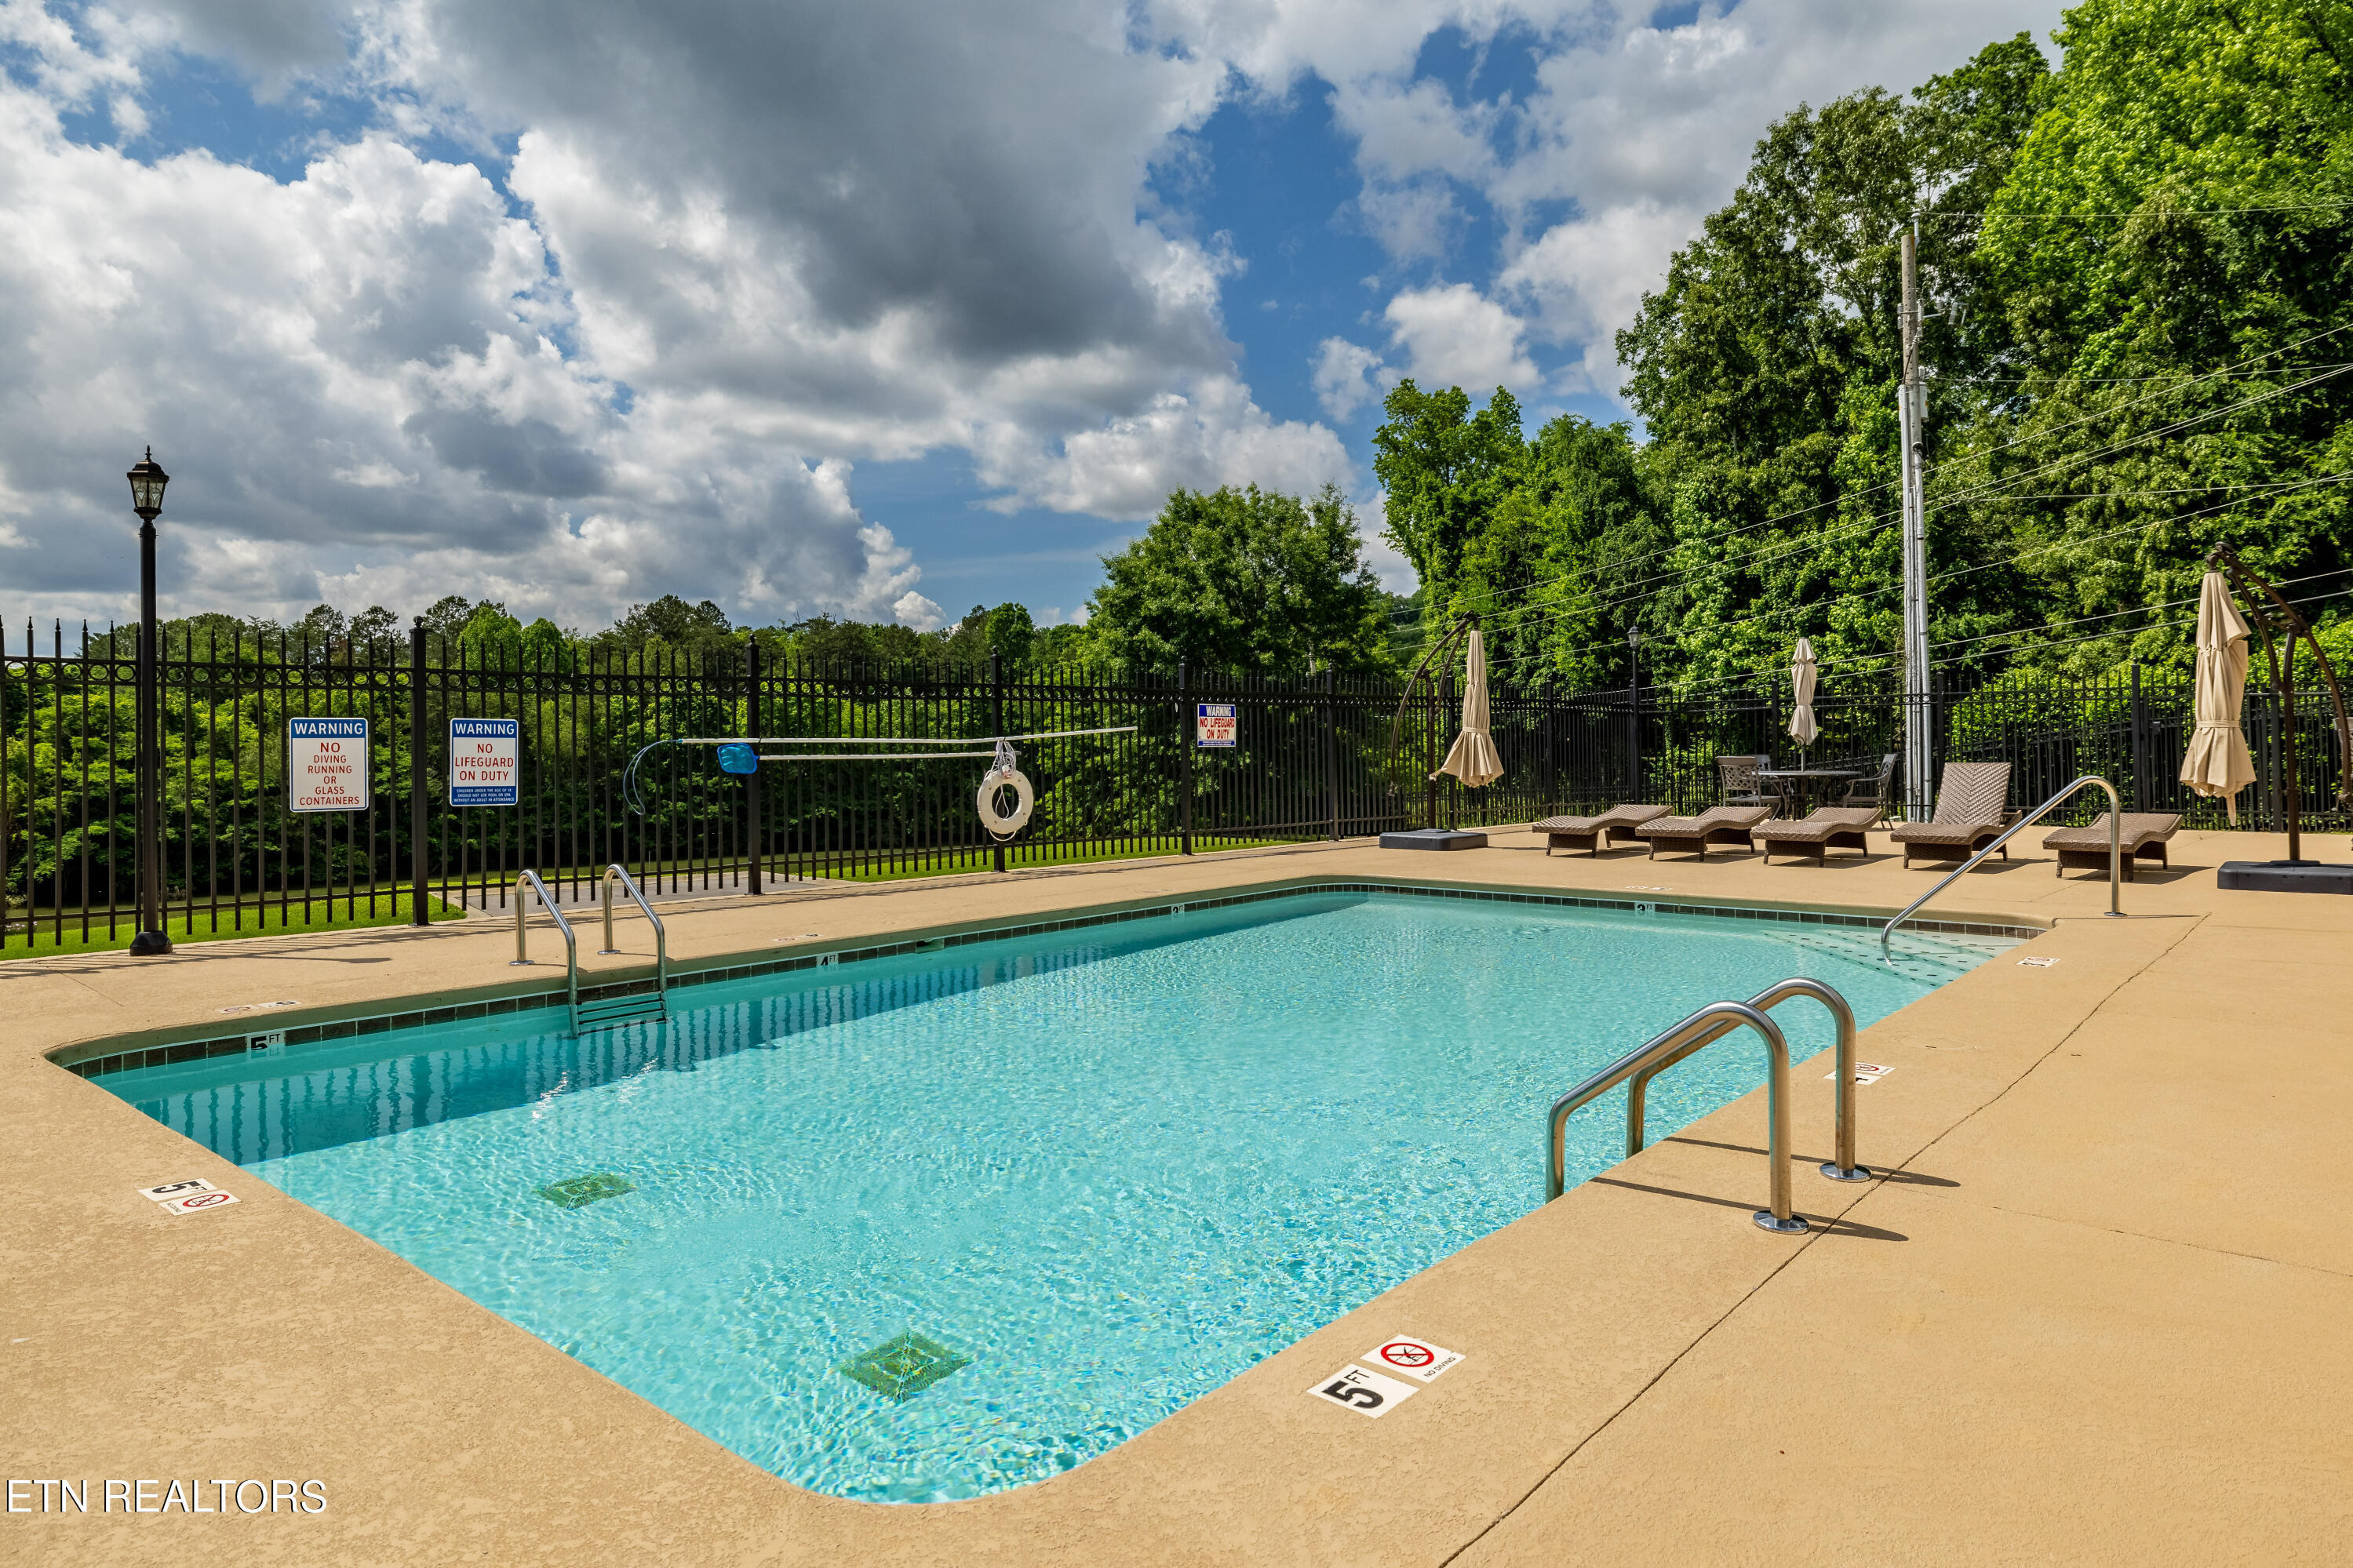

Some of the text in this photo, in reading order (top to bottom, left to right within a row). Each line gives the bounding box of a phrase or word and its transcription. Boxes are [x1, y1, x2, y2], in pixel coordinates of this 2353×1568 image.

[1206, 706, 1231, 716] WARNING
[1200, 718, 1234, 728] NO LIFEGUARD
[295, 723, 363, 734] WARNING
[455, 723, 515, 735] WARNING
[1207, 729, 1229, 739] ON DUTY
[321, 743, 341, 753] NO
[477, 744, 493, 753] NO
[455, 757, 514, 767] LIFEGUARD
[460, 771, 509, 780] ON DUTY
[300, 797, 359, 806] CONTAINERS
[251, 1034, 281, 1050] 5 FT
[152, 1181, 202, 1194] 5
[1423, 1356, 1457, 1378] NO DIVING
[1321, 1369, 1384, 1409] 5 FT
